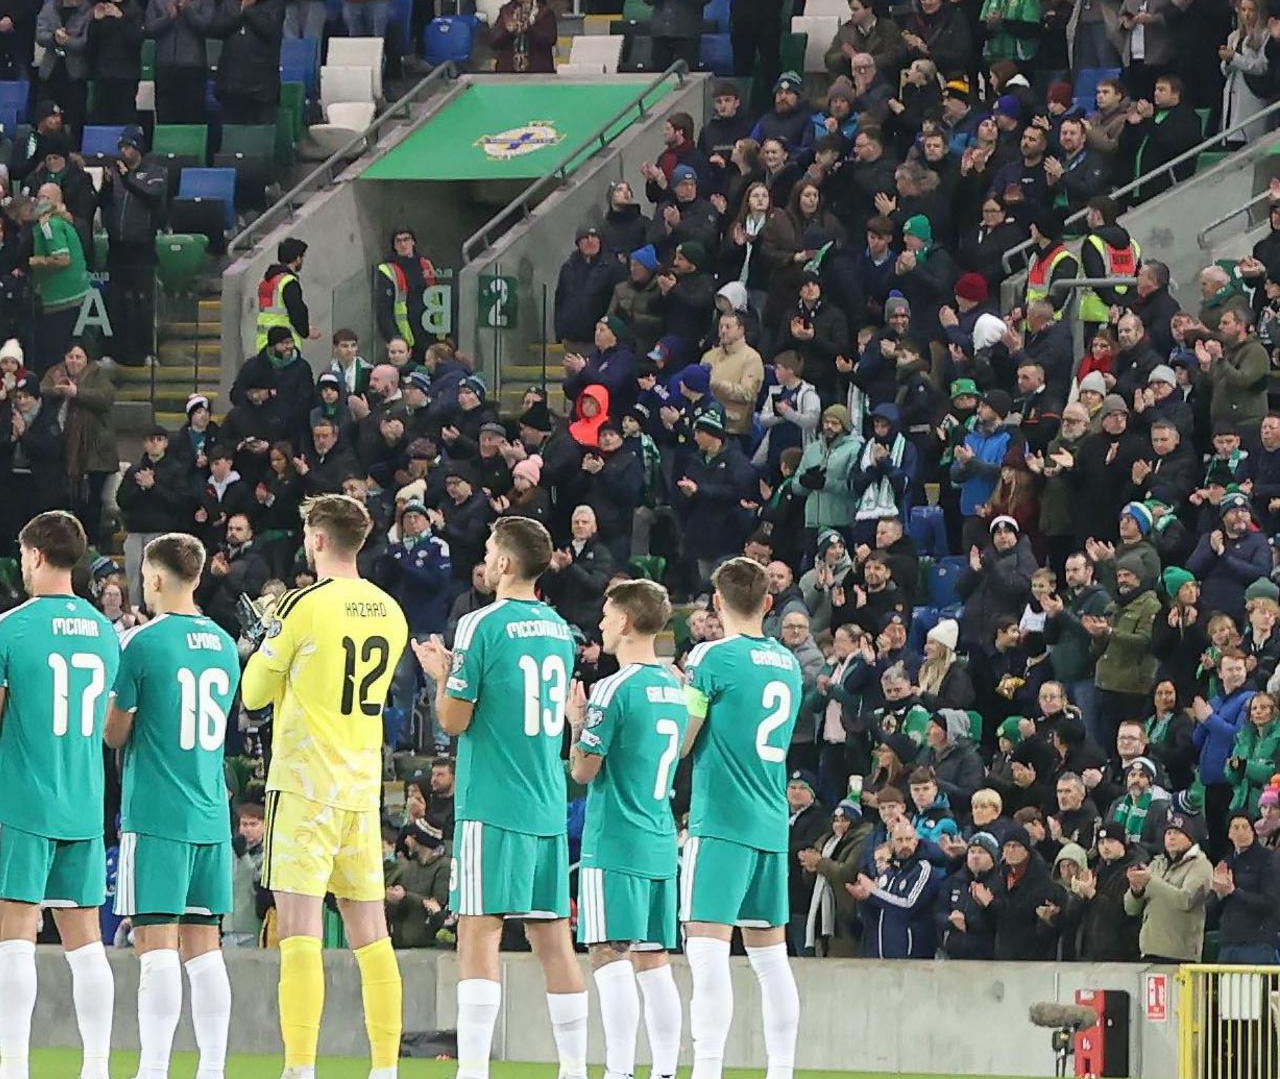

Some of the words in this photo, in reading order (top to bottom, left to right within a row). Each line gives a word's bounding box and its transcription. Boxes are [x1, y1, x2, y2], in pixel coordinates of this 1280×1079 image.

[72, 288, 114, 337] A
[488, 278, 508, 327] 2
[52, 617, 100, 637] MCNAIR
[186, 631, 222, 652] LYONS
[345, 601, 387, 618] HAZARD
[47, 652, 105, 737] 17
[176, 667, 230, 752] 16
[340, 635, 390, 716] 12
[518, 654, 567, 737] 13
[653, 719, 679, 801] 7
[755, 680, 791, 764] 2
